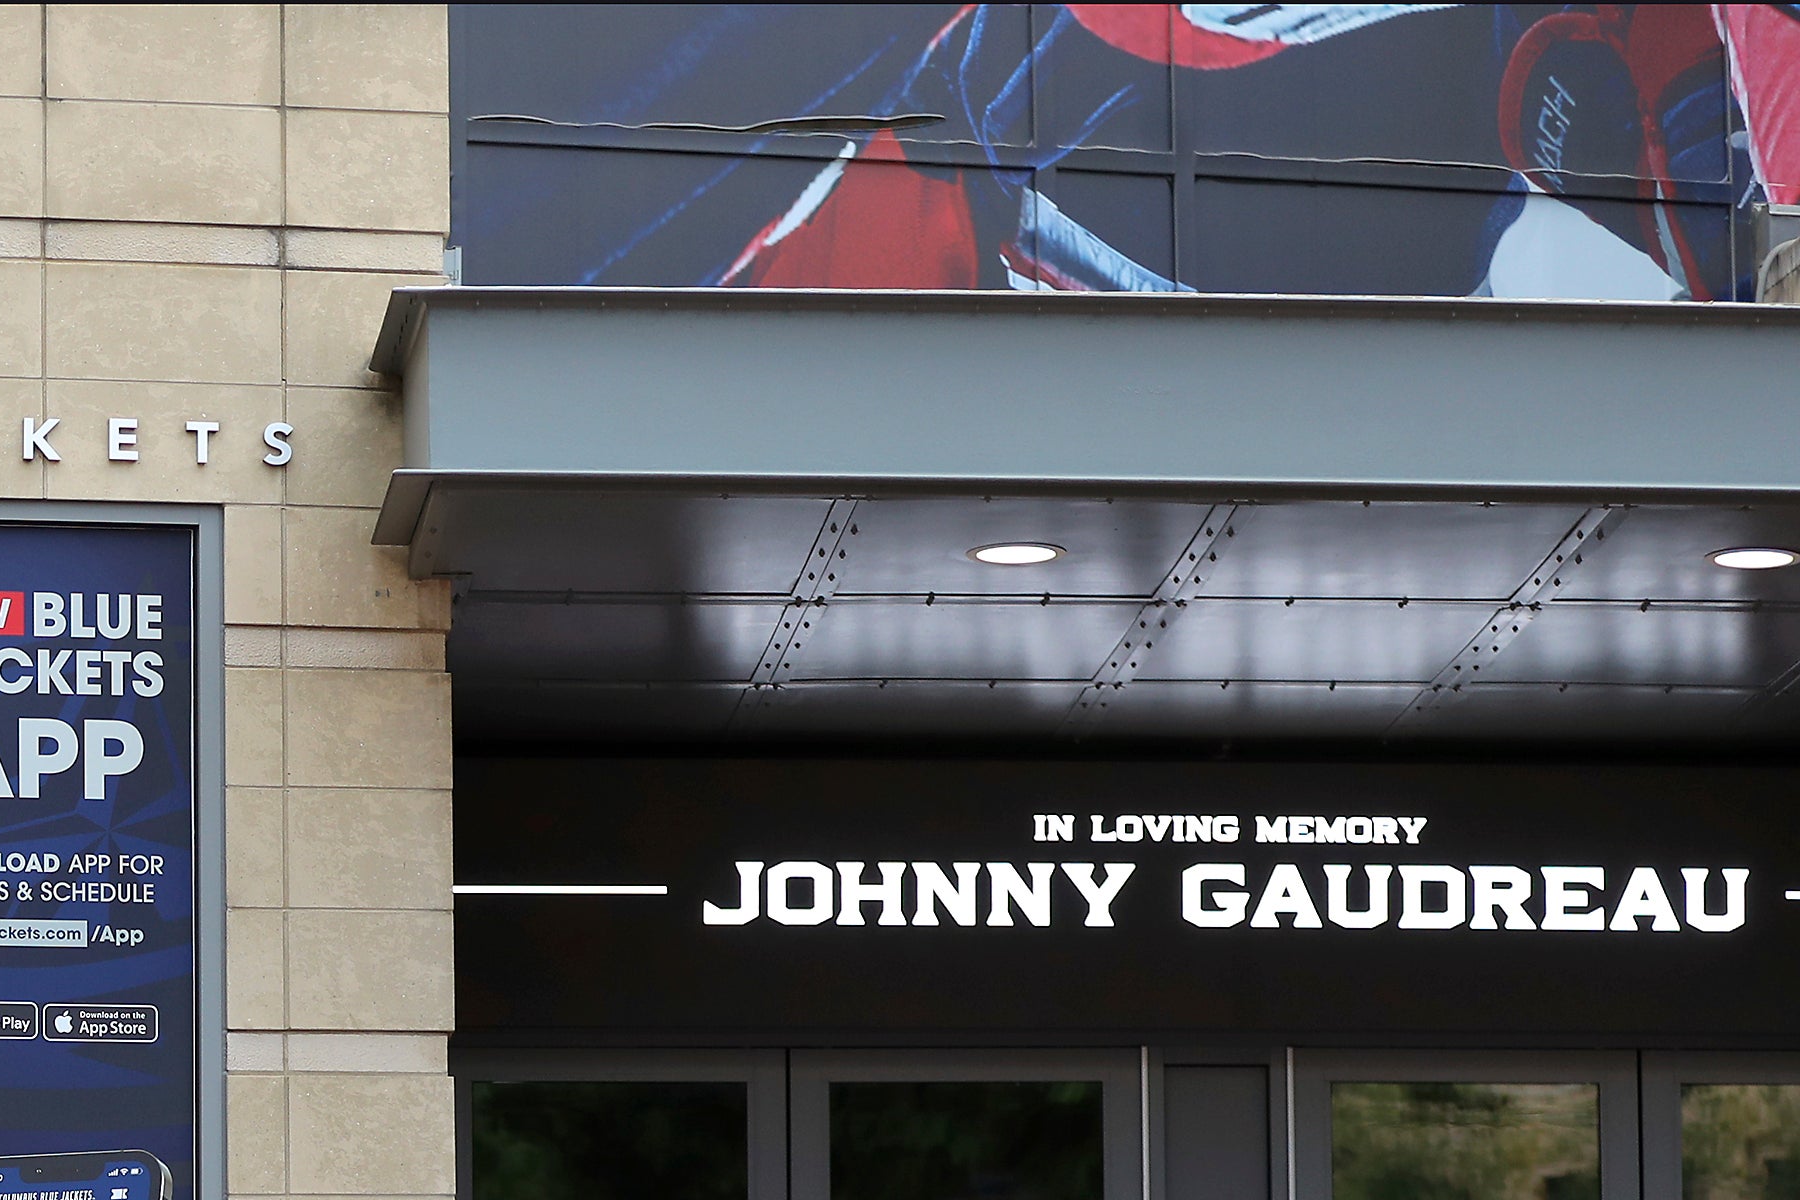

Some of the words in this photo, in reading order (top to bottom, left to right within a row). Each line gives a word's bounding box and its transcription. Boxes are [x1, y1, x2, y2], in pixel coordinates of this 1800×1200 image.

[33, 592, 162, 640] BLUE
[1033, 814, 1076, 842] IN
[1090, 815, 1240, 843] LOVING
[1254, 815, 1428, 844] MEMORY
[68, 854, 111, 874] APP
[118, 854, 164, 875] FOR
[16, 881, 33, 901] &
[40, 881, 155, 903] SCHEDULE
[703, 861, 1136, 927] JOHNNY
[1182, 863, 1750, 932] GAUDREAU
[2, 1016, 30, 1032] Play
[79, 1010, 118, 1019] Download
[132, 1011, 146, 1020] the
[79, 1021, 108, 1037] App
[110, 1021, 147, 1035] Store
